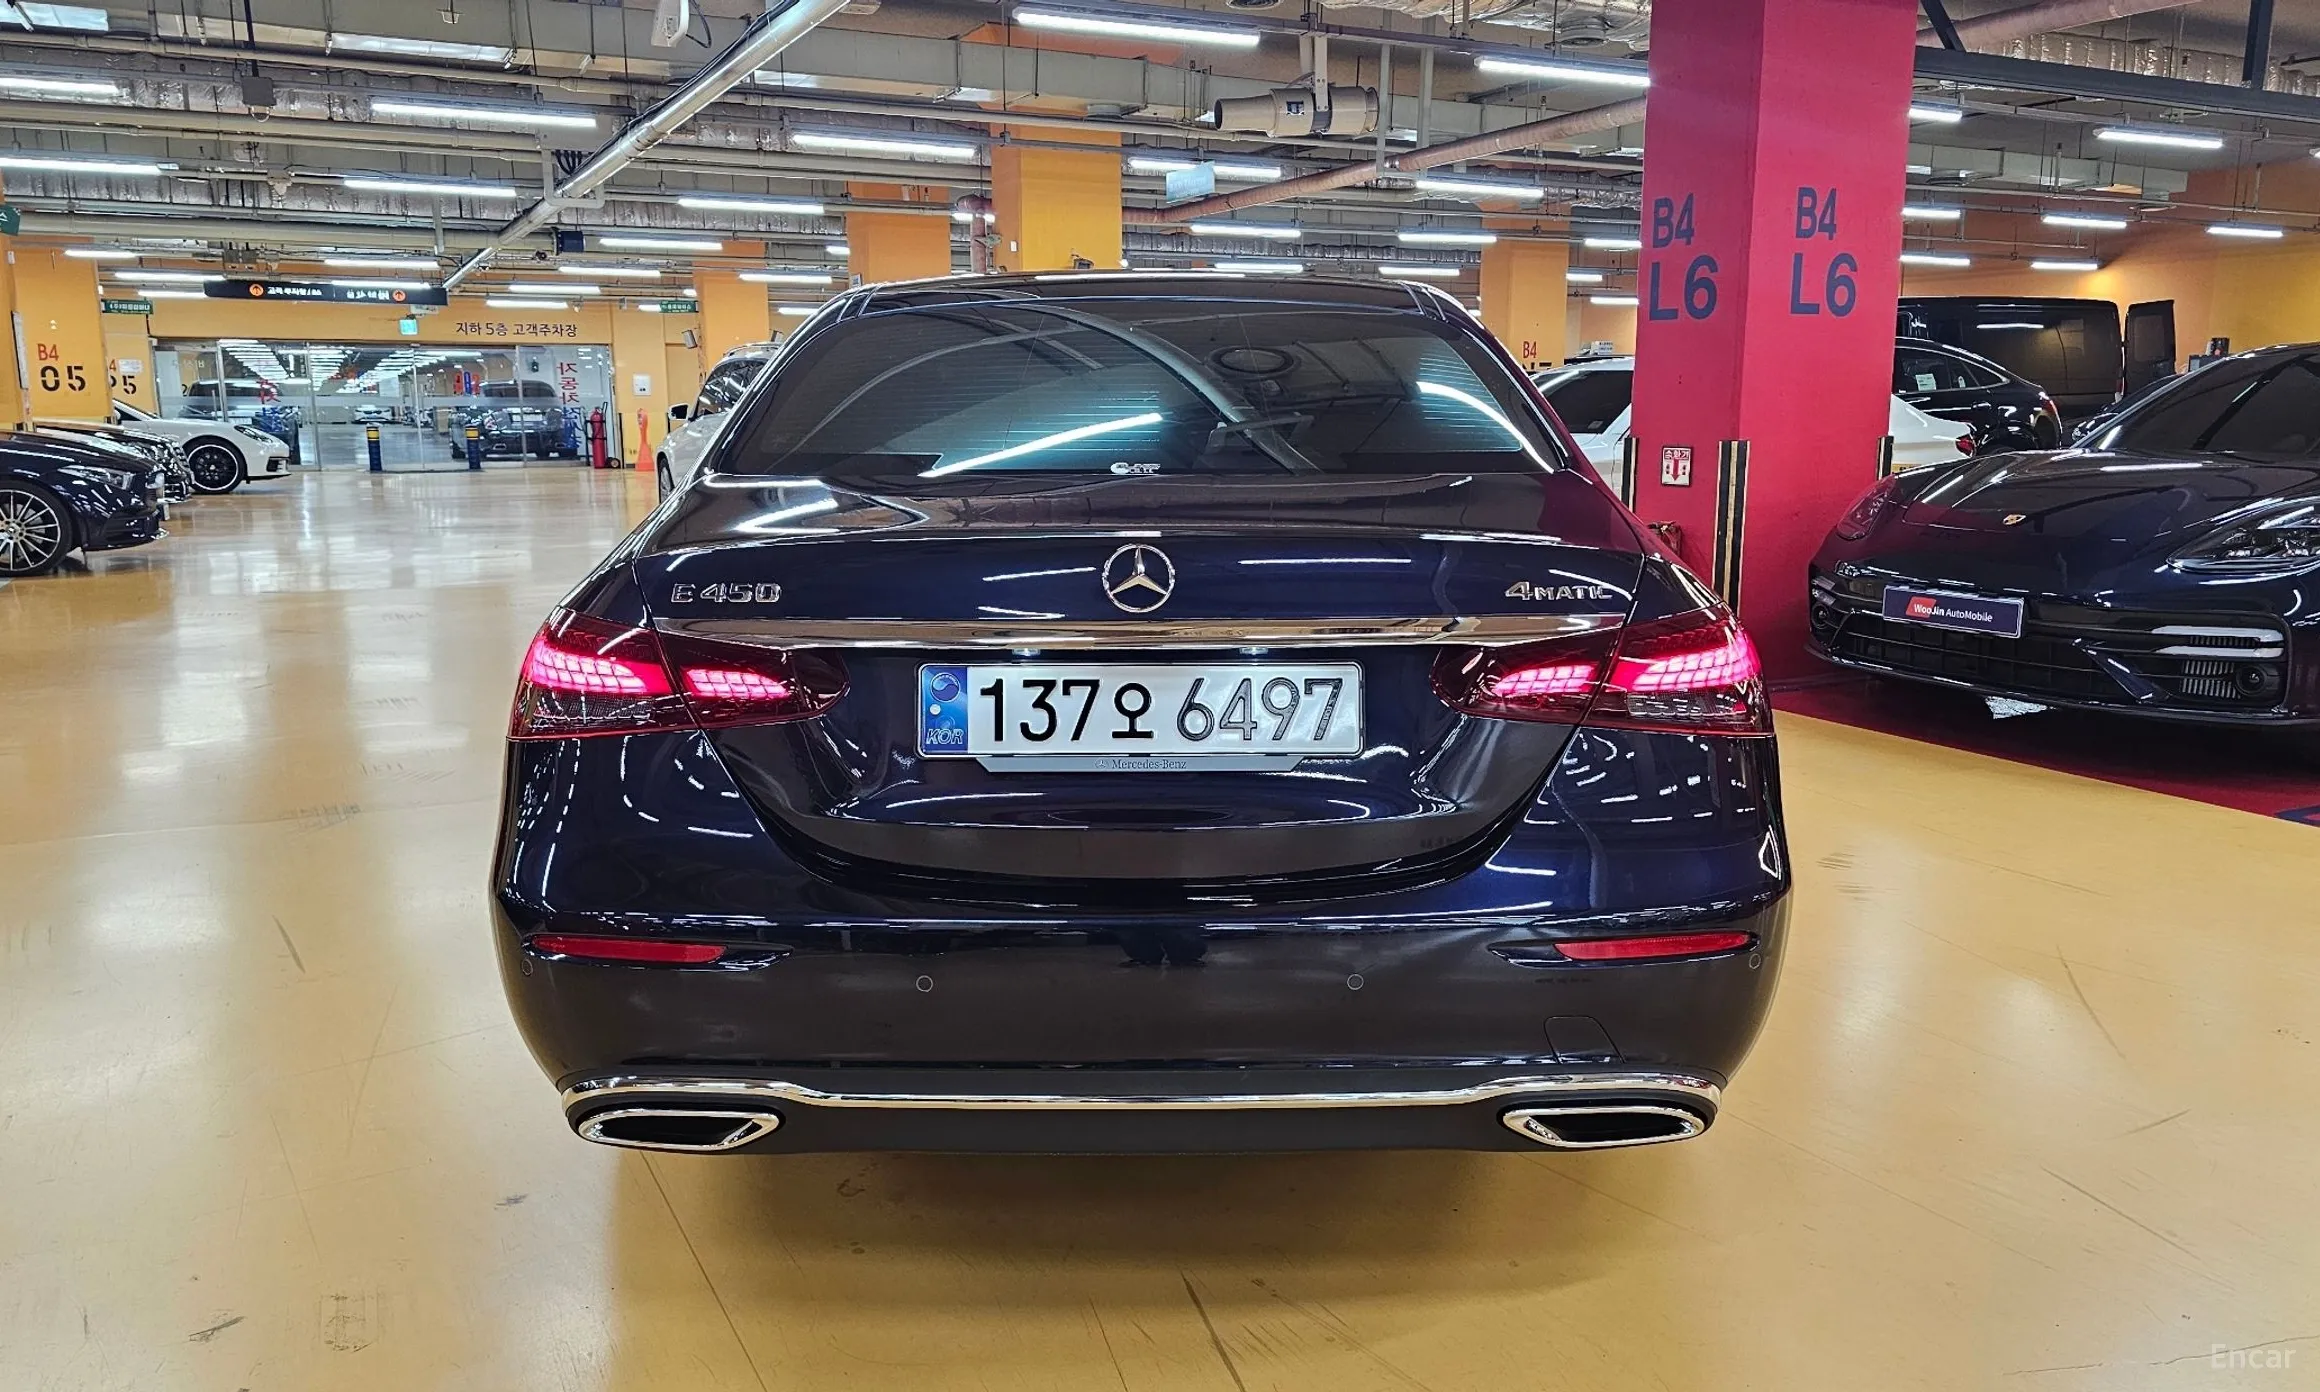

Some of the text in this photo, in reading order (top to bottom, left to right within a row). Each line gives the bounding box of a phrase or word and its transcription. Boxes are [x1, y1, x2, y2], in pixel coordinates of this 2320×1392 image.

[1652, 192, 1695, 248] B4
[1795, 187, 1837, 240] B4
[1648, 255, 1719, 321] L6
[1790, 252, 1858, 317] L6
[456, 322, 578, 337] 지하 5층 고객주차장
[37, 343, 59, 361] B4
[1522, 341, 1537, 358] B4
[41, 365, 86, 391] 05
[671, 583, 782, 603] E 450
[1504, 581, 1613, 601] 4MATIC
[1913, 603, 1993, 622] WooJin AutoMobile
[980, 677, 1343, 742] 137오 6497
[925, 728, 965, 745] KOR
[1111, 758, 1187, 770] Mercedes-Benz
